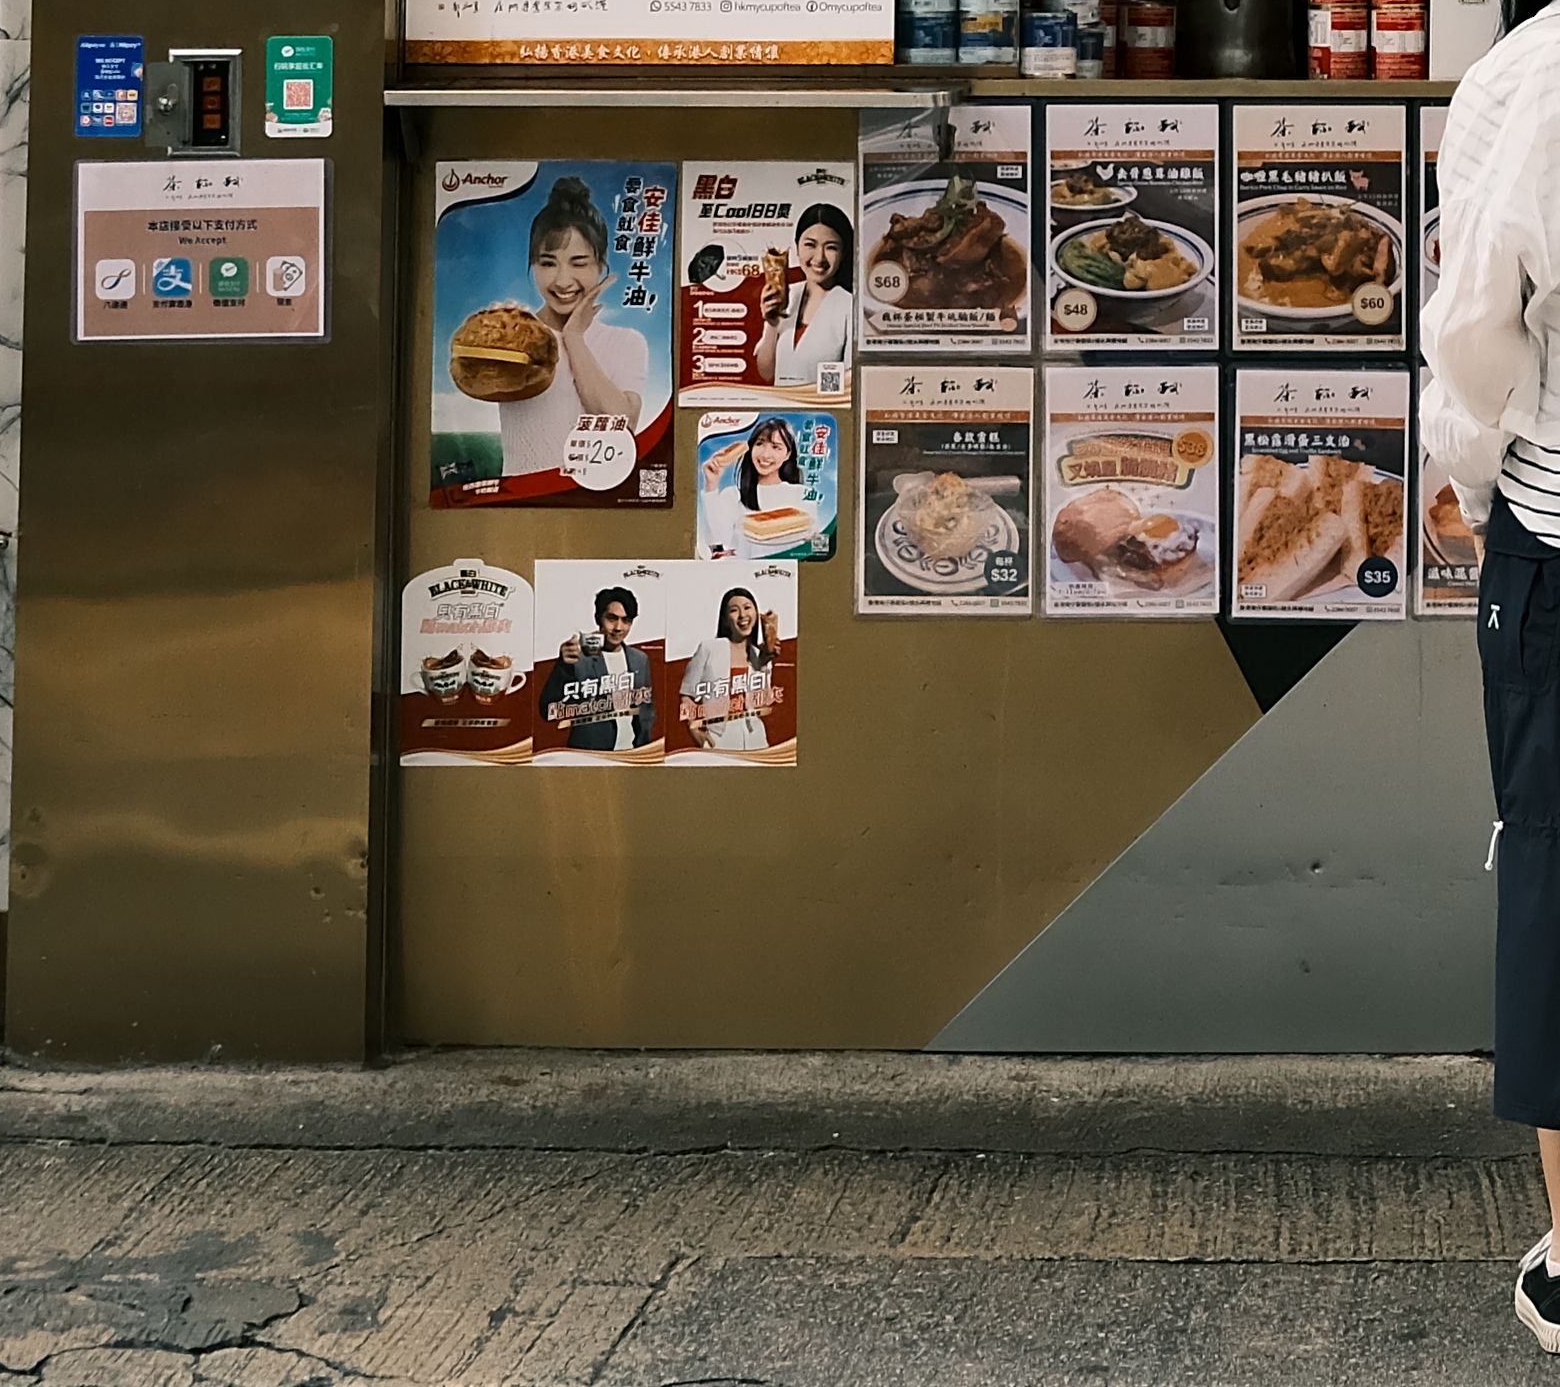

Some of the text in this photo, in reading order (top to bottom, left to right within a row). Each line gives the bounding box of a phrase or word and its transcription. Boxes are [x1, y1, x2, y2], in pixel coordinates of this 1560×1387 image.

[663, 1, 713, 12] 5543 7833
[734, 0, 802, 14] hkmycupoftea
[464, 172, 508, 187] Anchor
[692, 174, 738, 200] 黑白
[147, 219, 258, 232] 本店接受以下支付方式
[178, 235, 227, 246] We Accept
[874, 276, 901, 289] $68
[1063, 303, 1089, 316] $48
[1360, 297, 1385, 310] $60
[576, 415, 628, 433] 菠蘿油
[713, 416, 741, 424] Anchor
[991, 568, 1018, 582] $32
[1364, 570, 1391, 584] $35
[563, 672, 635, 703] 只有黑白
[695, 670, 768, 702] 只有黑白
